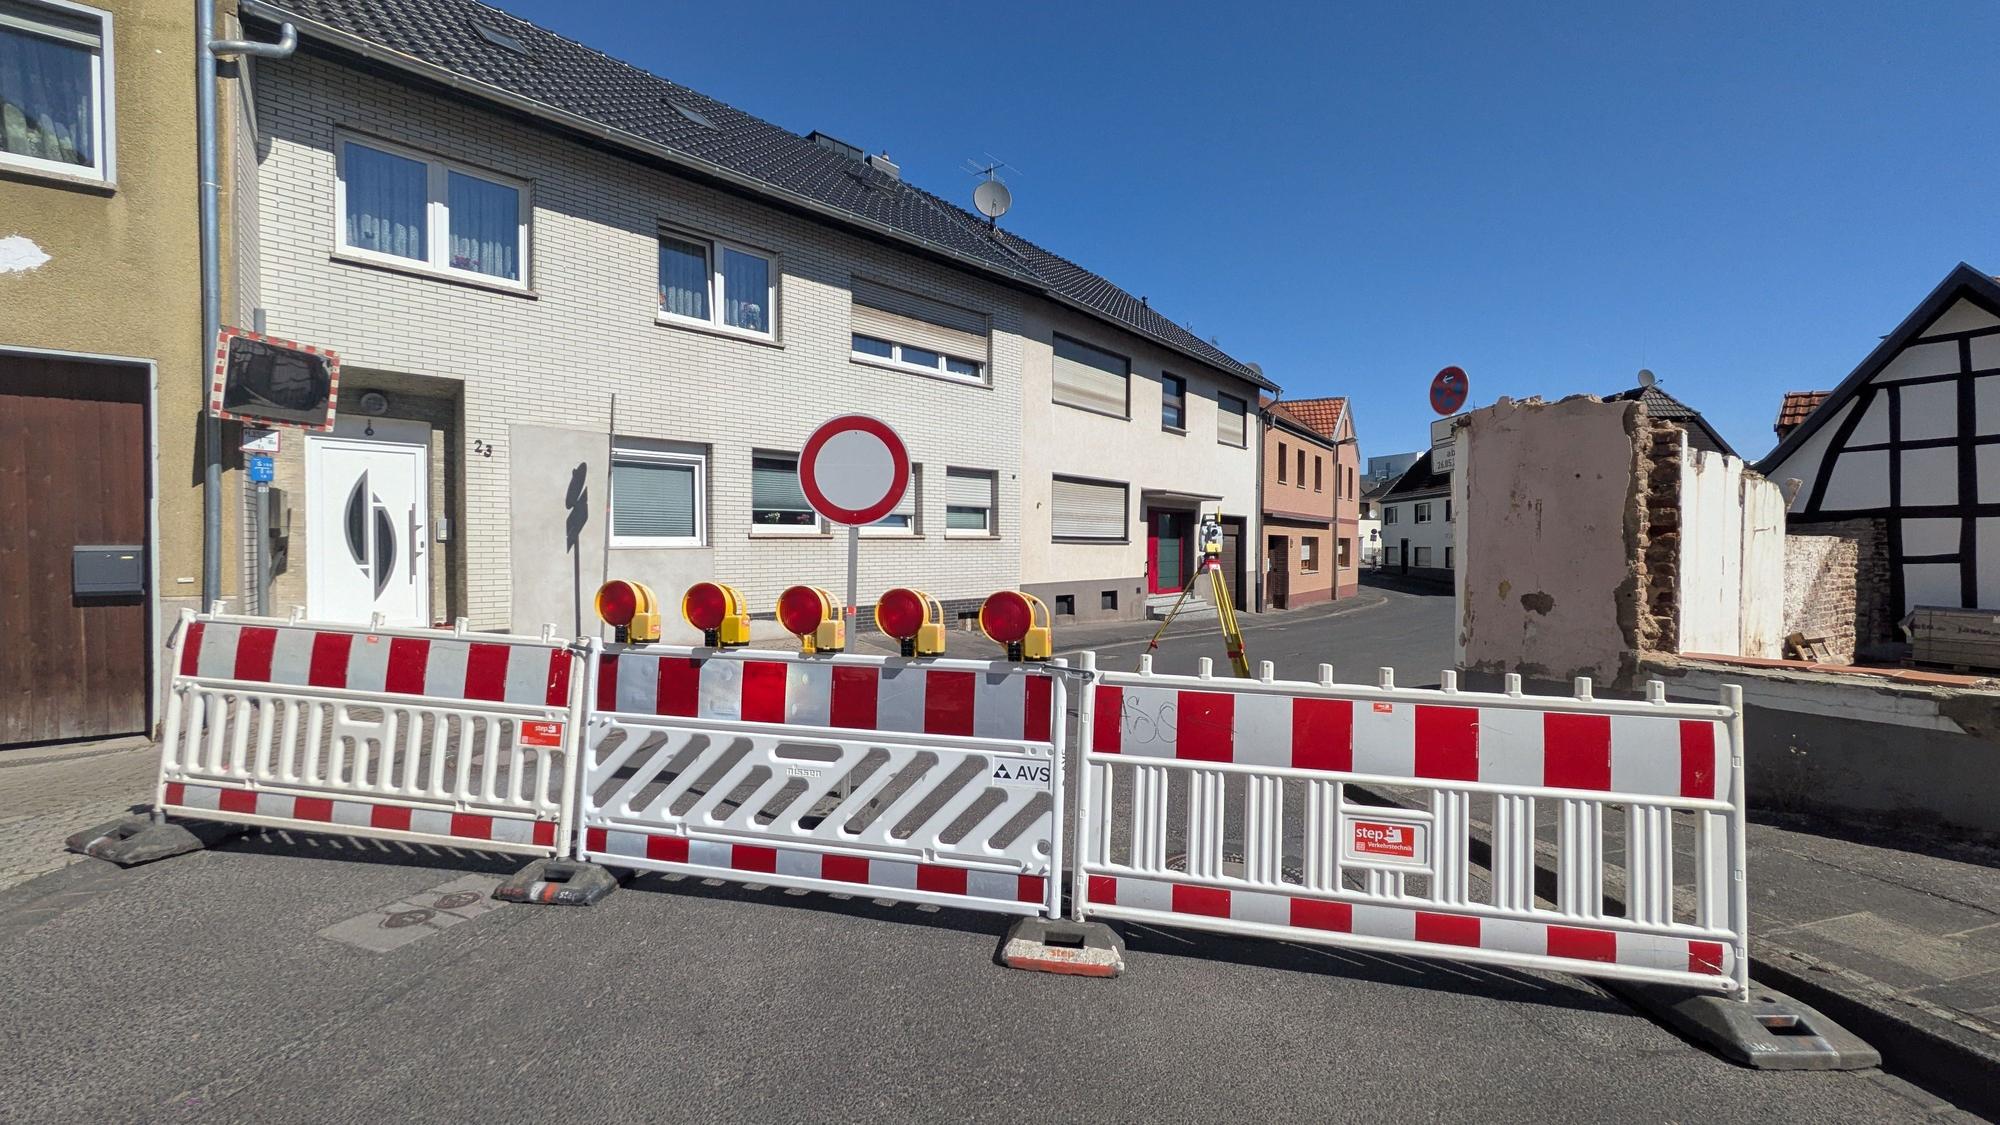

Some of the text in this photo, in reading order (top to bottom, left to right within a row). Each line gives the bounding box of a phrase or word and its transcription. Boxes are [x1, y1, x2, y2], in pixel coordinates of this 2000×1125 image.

[474, 439, 493, 458] 23
[786, 764, 823, 778] nissen
[1015, 765, 1051, 782] AVS
[1356, 828, 1384, 842] step
[1367, 841, 1413, 851] Verkehrstechnik
